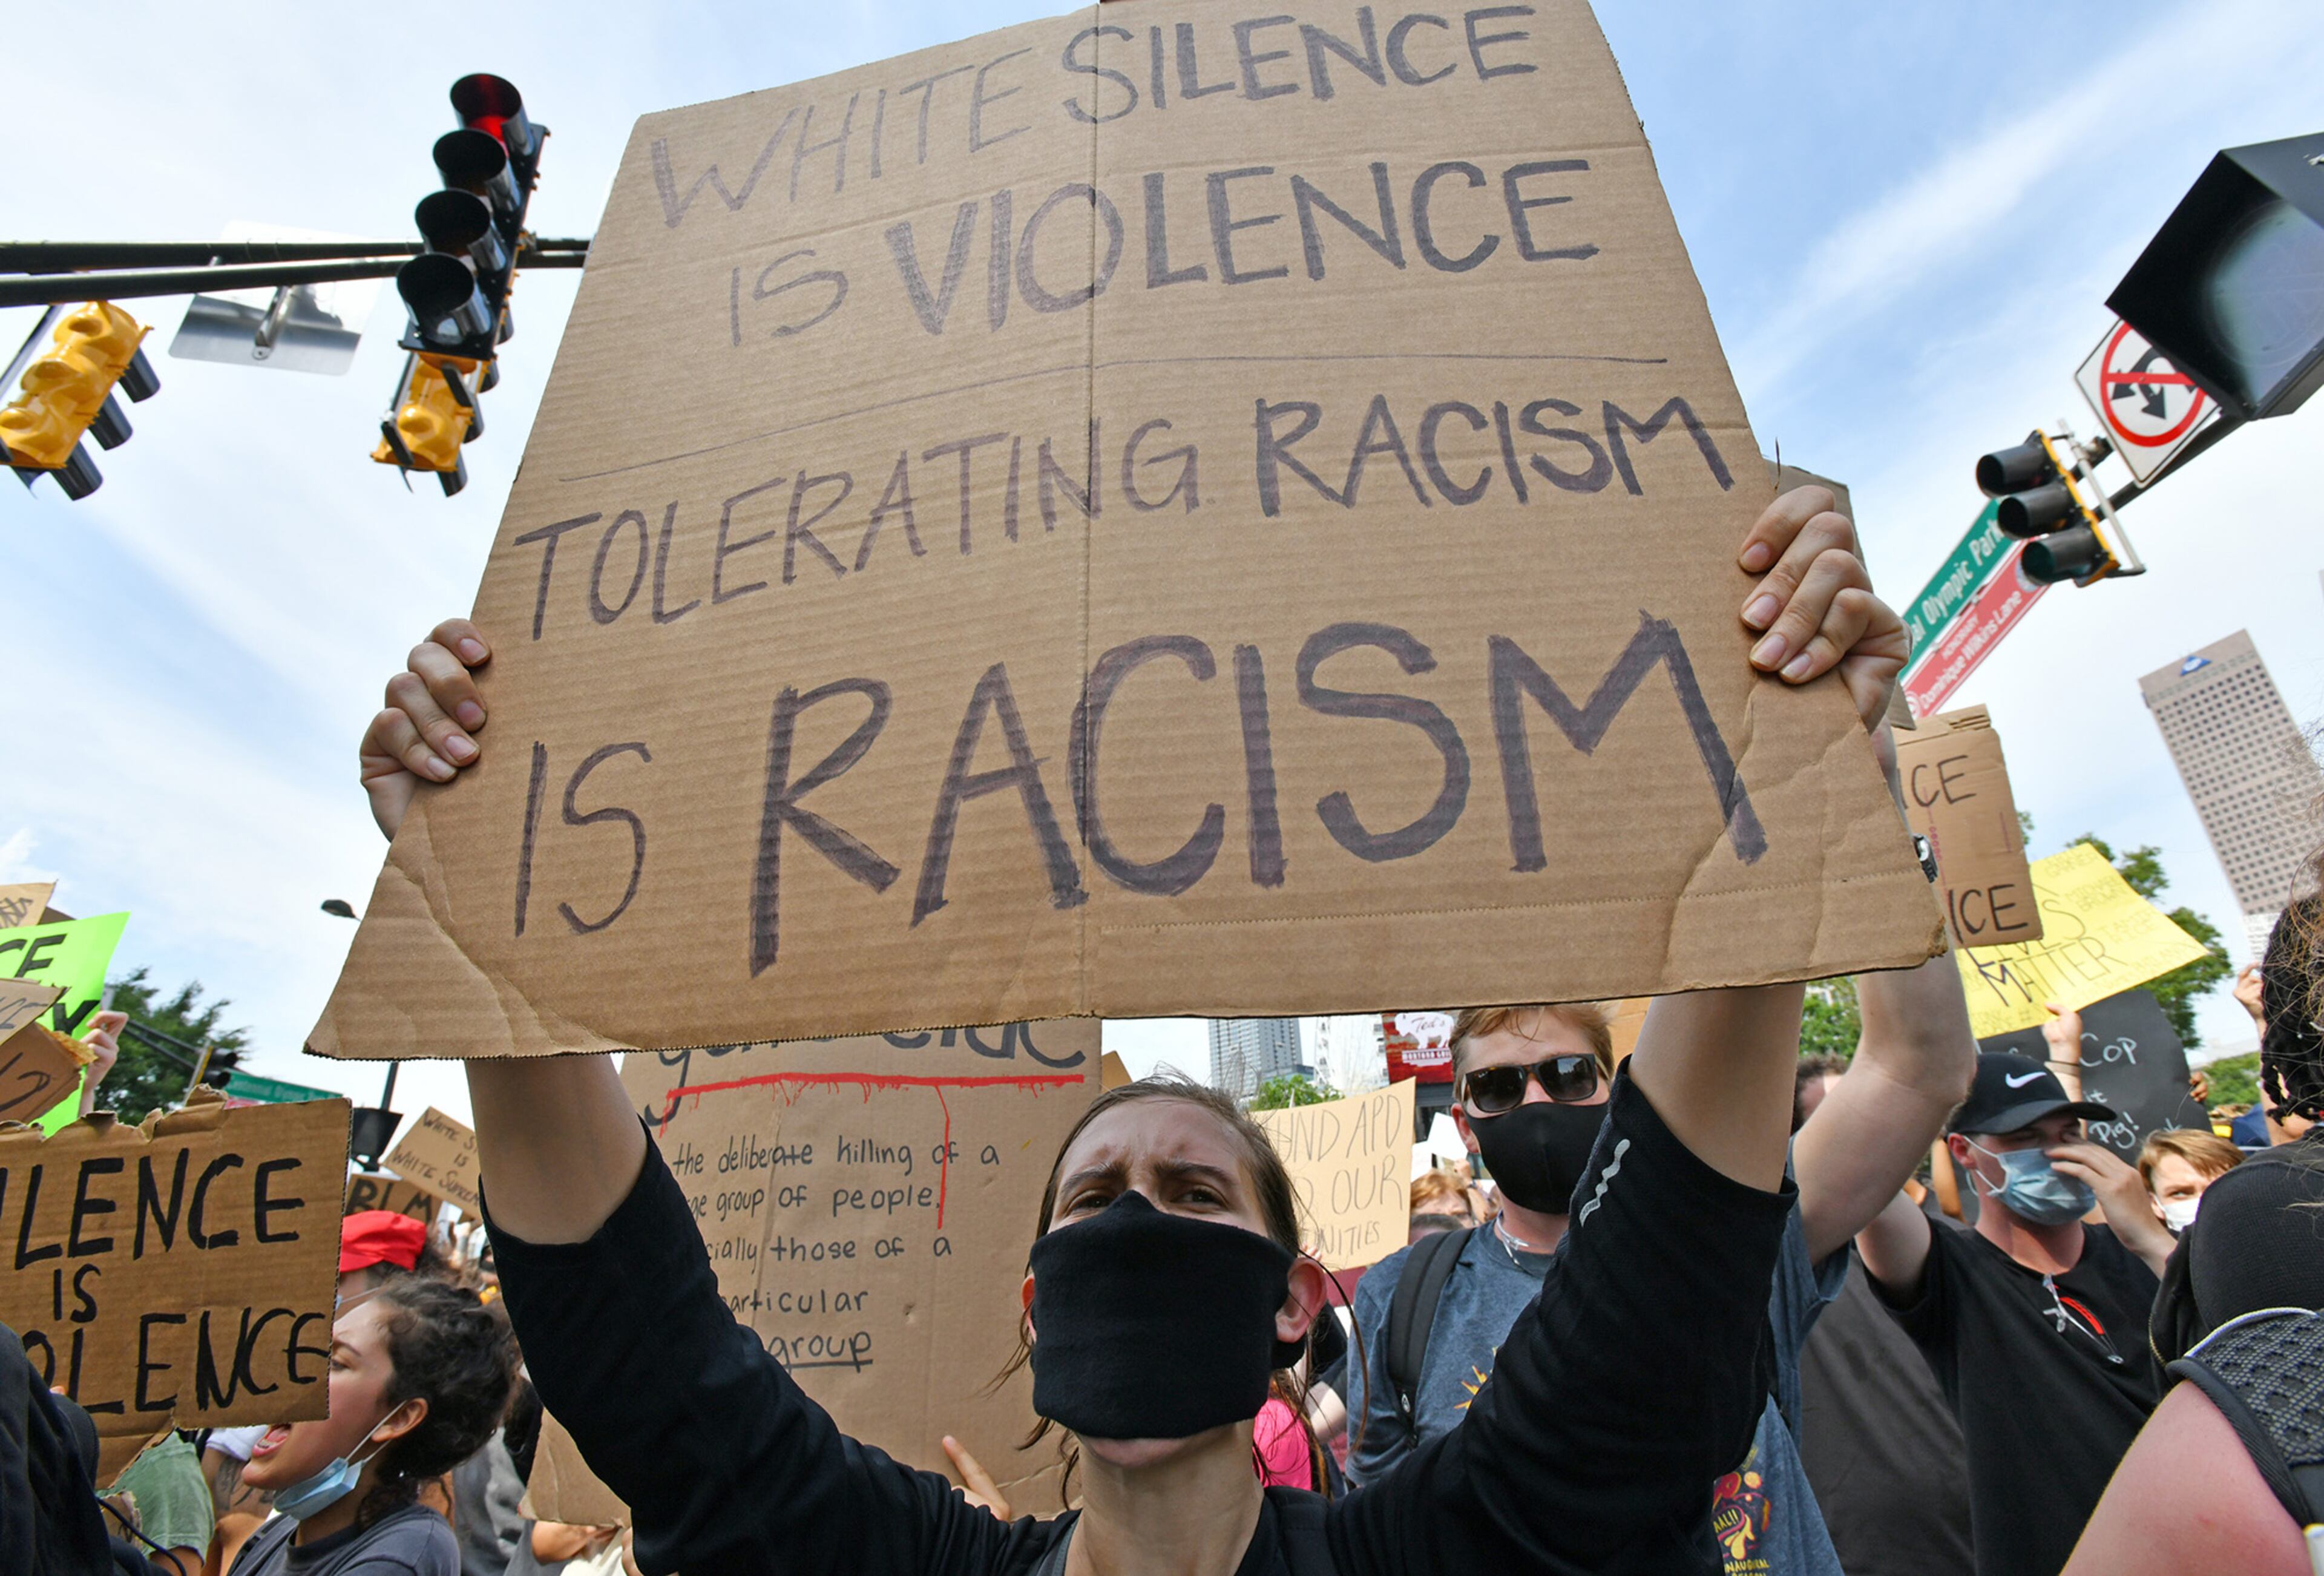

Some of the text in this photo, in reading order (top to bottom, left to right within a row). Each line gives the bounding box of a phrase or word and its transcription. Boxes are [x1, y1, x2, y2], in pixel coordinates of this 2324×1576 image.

[651, 5, 1538, 228] WHITE SILENCE
[731, 159, 1600, 347] IS VIOLENCE
[514, 395, 1735, 640] TOLERATING RACISM
[1922, 561, 1974, 625] Olympic
[1920, 590, 2023, 710] Dominique Wilkins Lane
[515, 609, 1768, 978] IS RACISM
[1978, 936, 2129, 1007] MATTER
[423, 1109, 461, 1141] WHITE
[673, 1134, 999, 1176] the deliberate killing of a
[1347, 1095, 1401, 1158] APD
[392, 1145, 437, 1179] WHITE
[1332, 1155, 1402, 1212] OUR
[717, 1189, 764, 1222] group
[778, 1185, 807, 1207] of
[770, 1236, 856, 1261] those
[875, 1235, 904, 1258] of
[934, 1236, 952, 1257] a
[53, 1264, 101, 1323] IS
[767, 1331, 872, 1377] group
